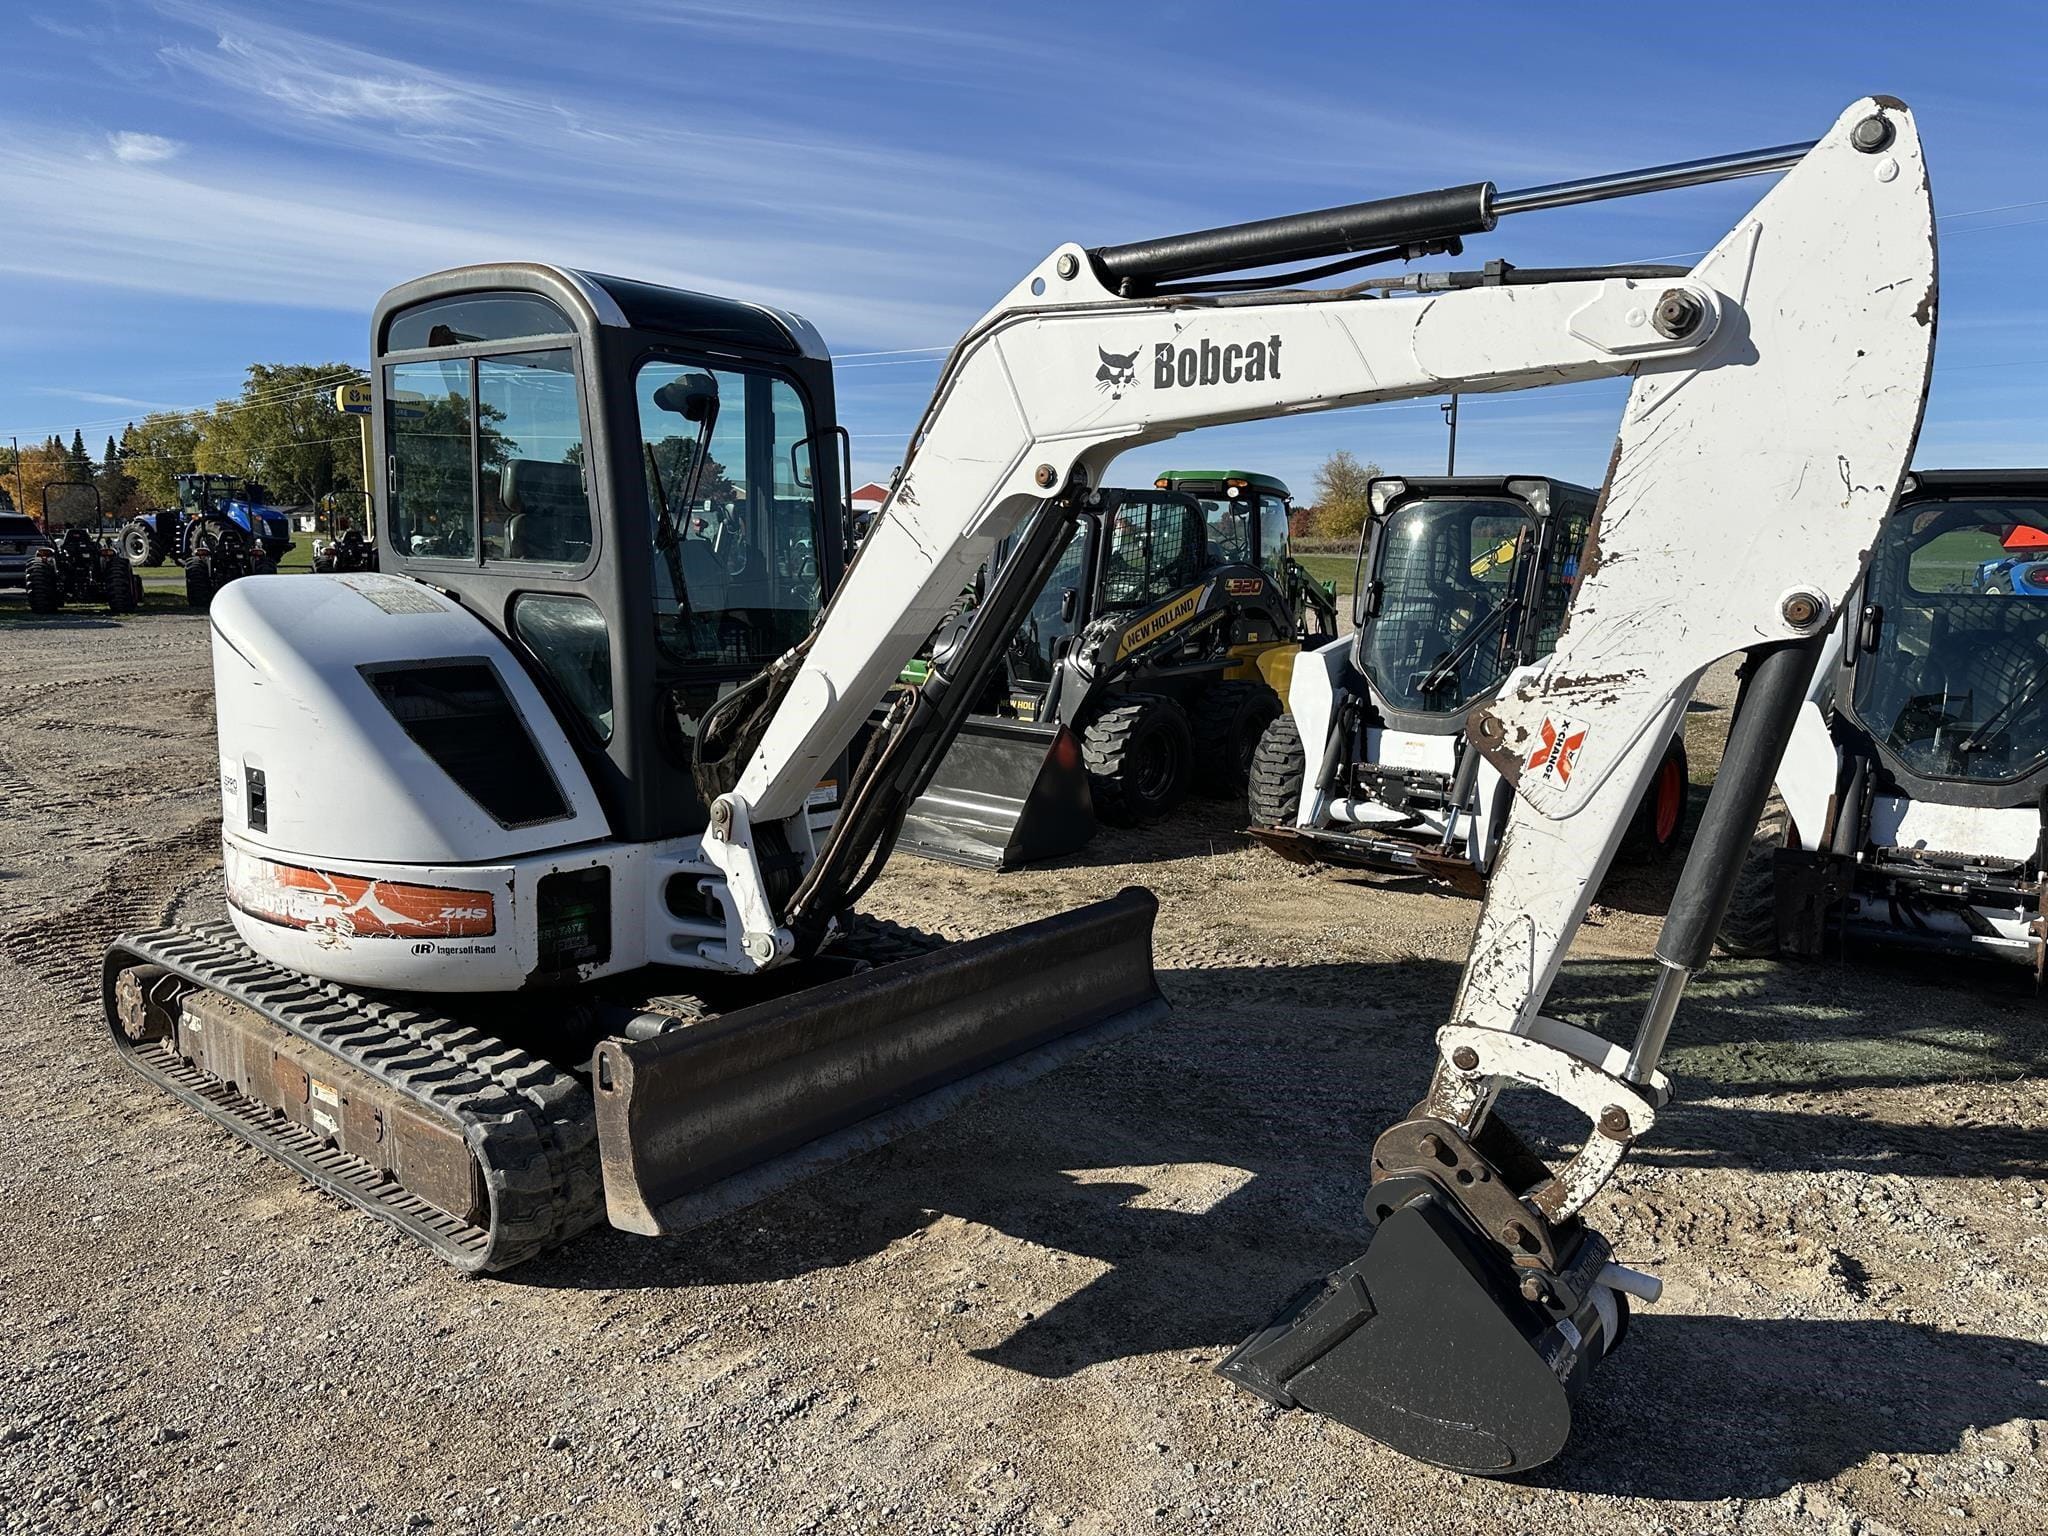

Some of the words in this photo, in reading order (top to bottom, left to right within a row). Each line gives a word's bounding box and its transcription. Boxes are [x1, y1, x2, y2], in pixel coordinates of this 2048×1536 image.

[1154, 334, 1282, 389] Bobcat
[1225, 579, 1263, 596] L320
[1127, 625, 1150, 647] NEW
[1151, 598, 1194, 633] HOLLAND
[1542, 720, 1571, 780] X-CHANGE
[439, 907, 488, 919] ZHS
